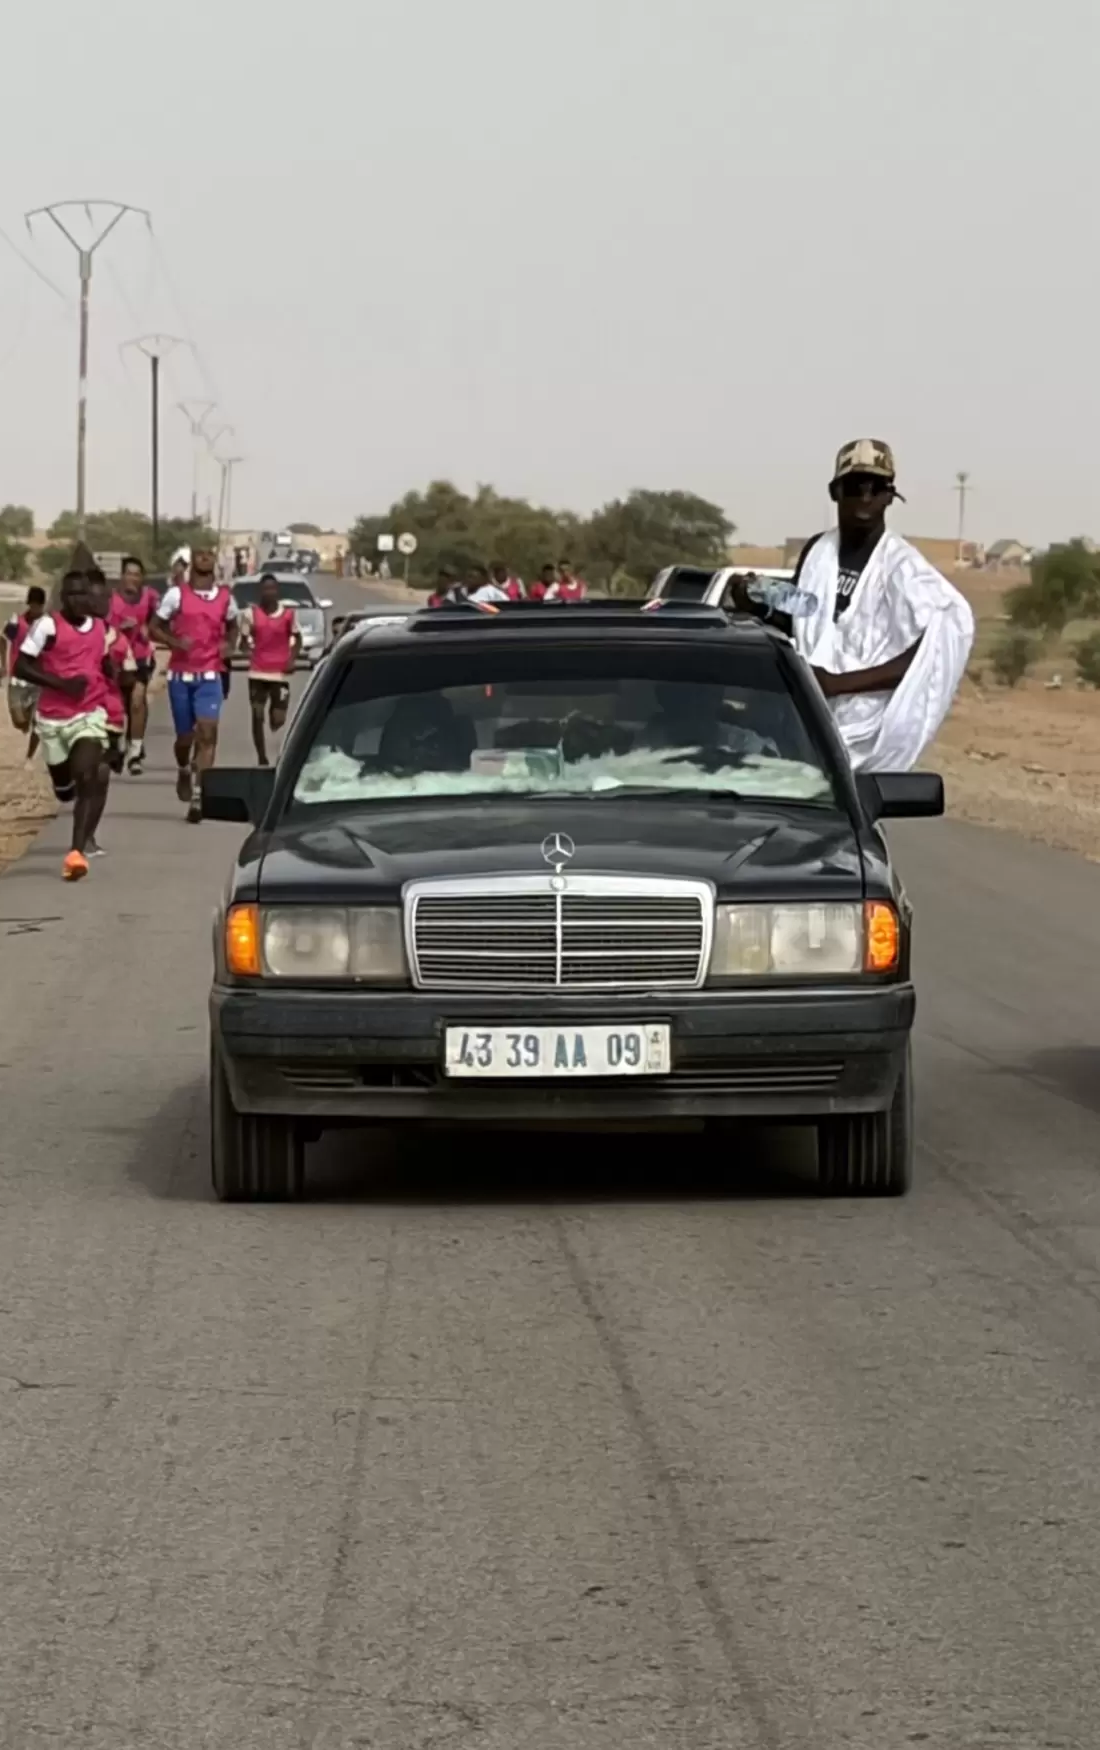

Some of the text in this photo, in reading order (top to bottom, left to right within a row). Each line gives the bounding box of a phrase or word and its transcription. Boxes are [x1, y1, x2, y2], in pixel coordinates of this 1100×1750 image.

[456, 1032, 641, 1069] 43 39 AA 09
